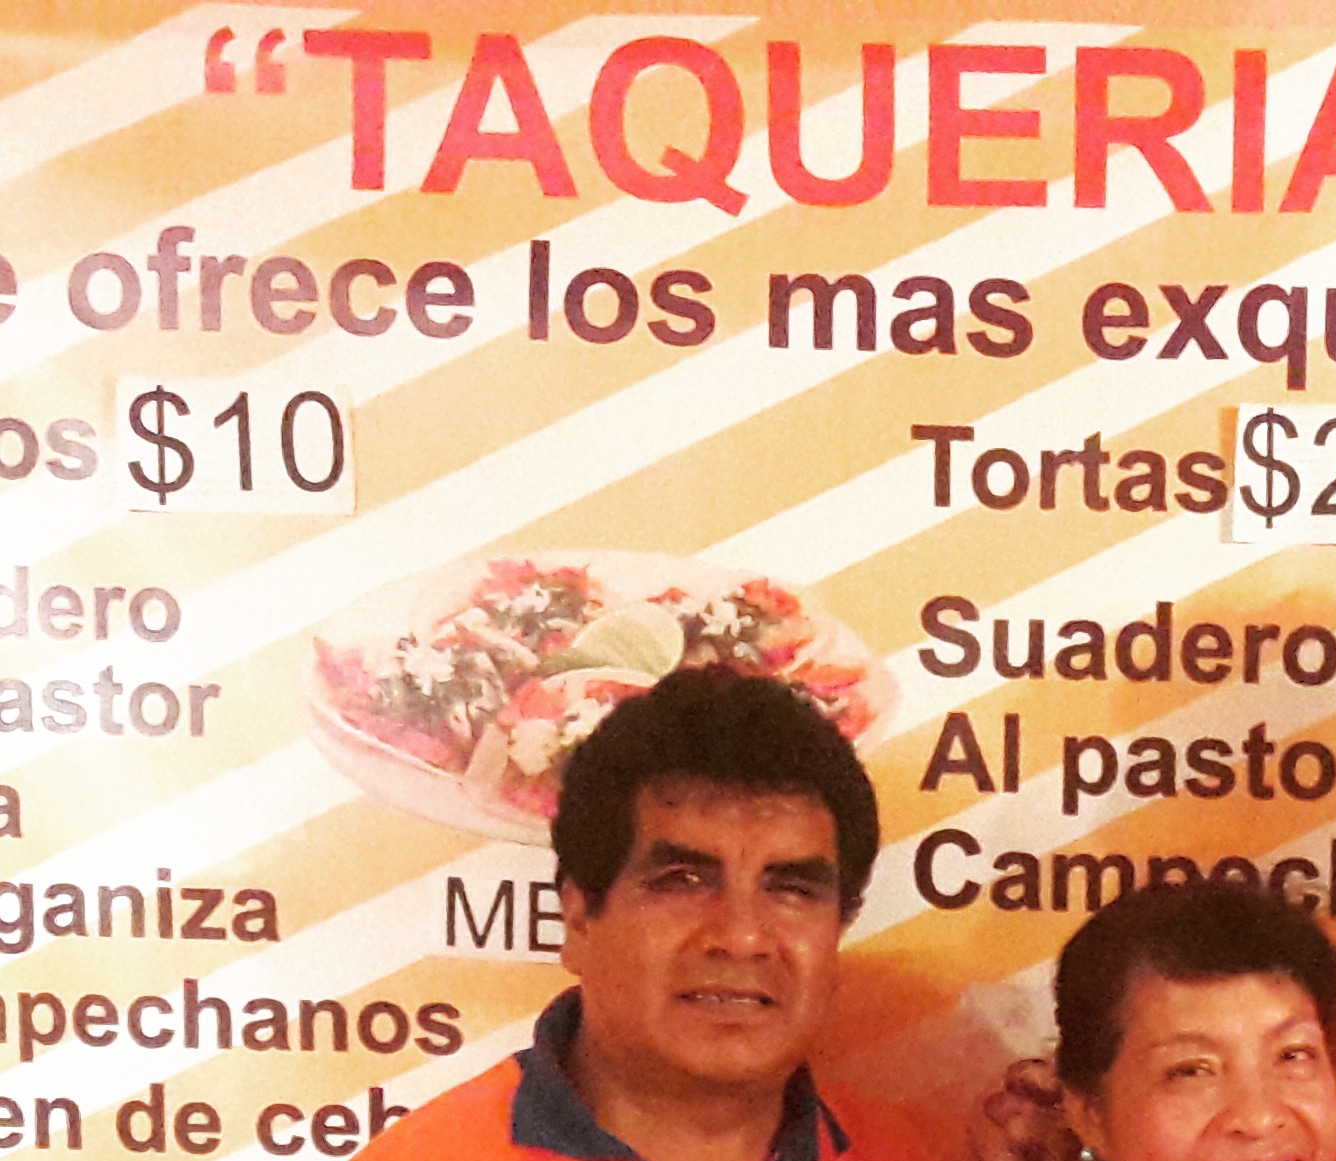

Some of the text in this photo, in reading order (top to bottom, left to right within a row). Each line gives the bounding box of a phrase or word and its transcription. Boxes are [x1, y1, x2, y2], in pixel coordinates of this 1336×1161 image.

[68, 226, 476, 338] ofrece
[529, 240, 717, 347] los
[768, 272, 1033, 359] mas
[128, 384, 345, 506] $10
[911, 424, 1229, 513] Tortas
[919, 712, 1020, 793] Al
[0, 978, 463, 1062] pechanos
[115, 1083, 222, 1155] de
